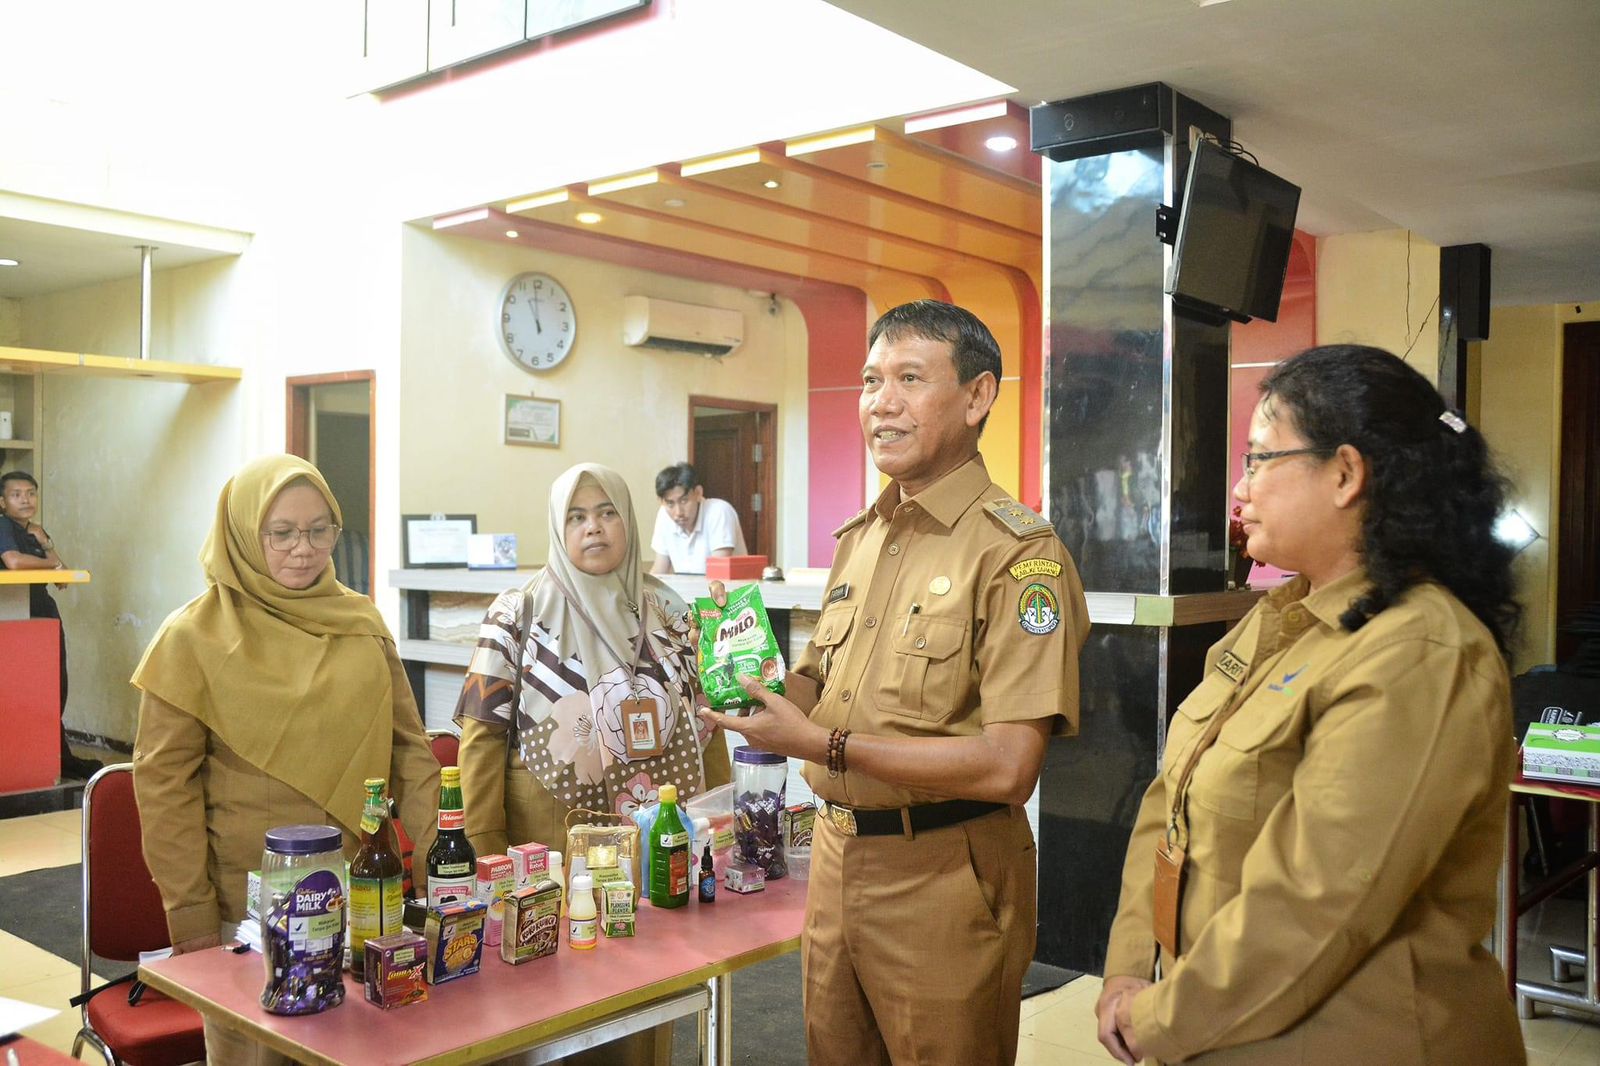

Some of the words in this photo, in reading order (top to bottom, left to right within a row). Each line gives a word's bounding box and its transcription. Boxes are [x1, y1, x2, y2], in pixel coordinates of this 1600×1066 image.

[559, 302, 567, 312] 2
[502, 313, 511, 323] 9
[561, 321, 569, 332] 3
[506, 333, 514, 343] 8
[556, 339, 564, 349] 4
[516, 348, 524, 358] 7
[546, 352, 555, 363] 5
[531, 356, 540, 366] 6
[719, 614, 755, 642] MILO
[296, 891, 327, 904] DAIRY
[296, 901, 322, 912] MILK
[445, 934, 477, 961] STARS
